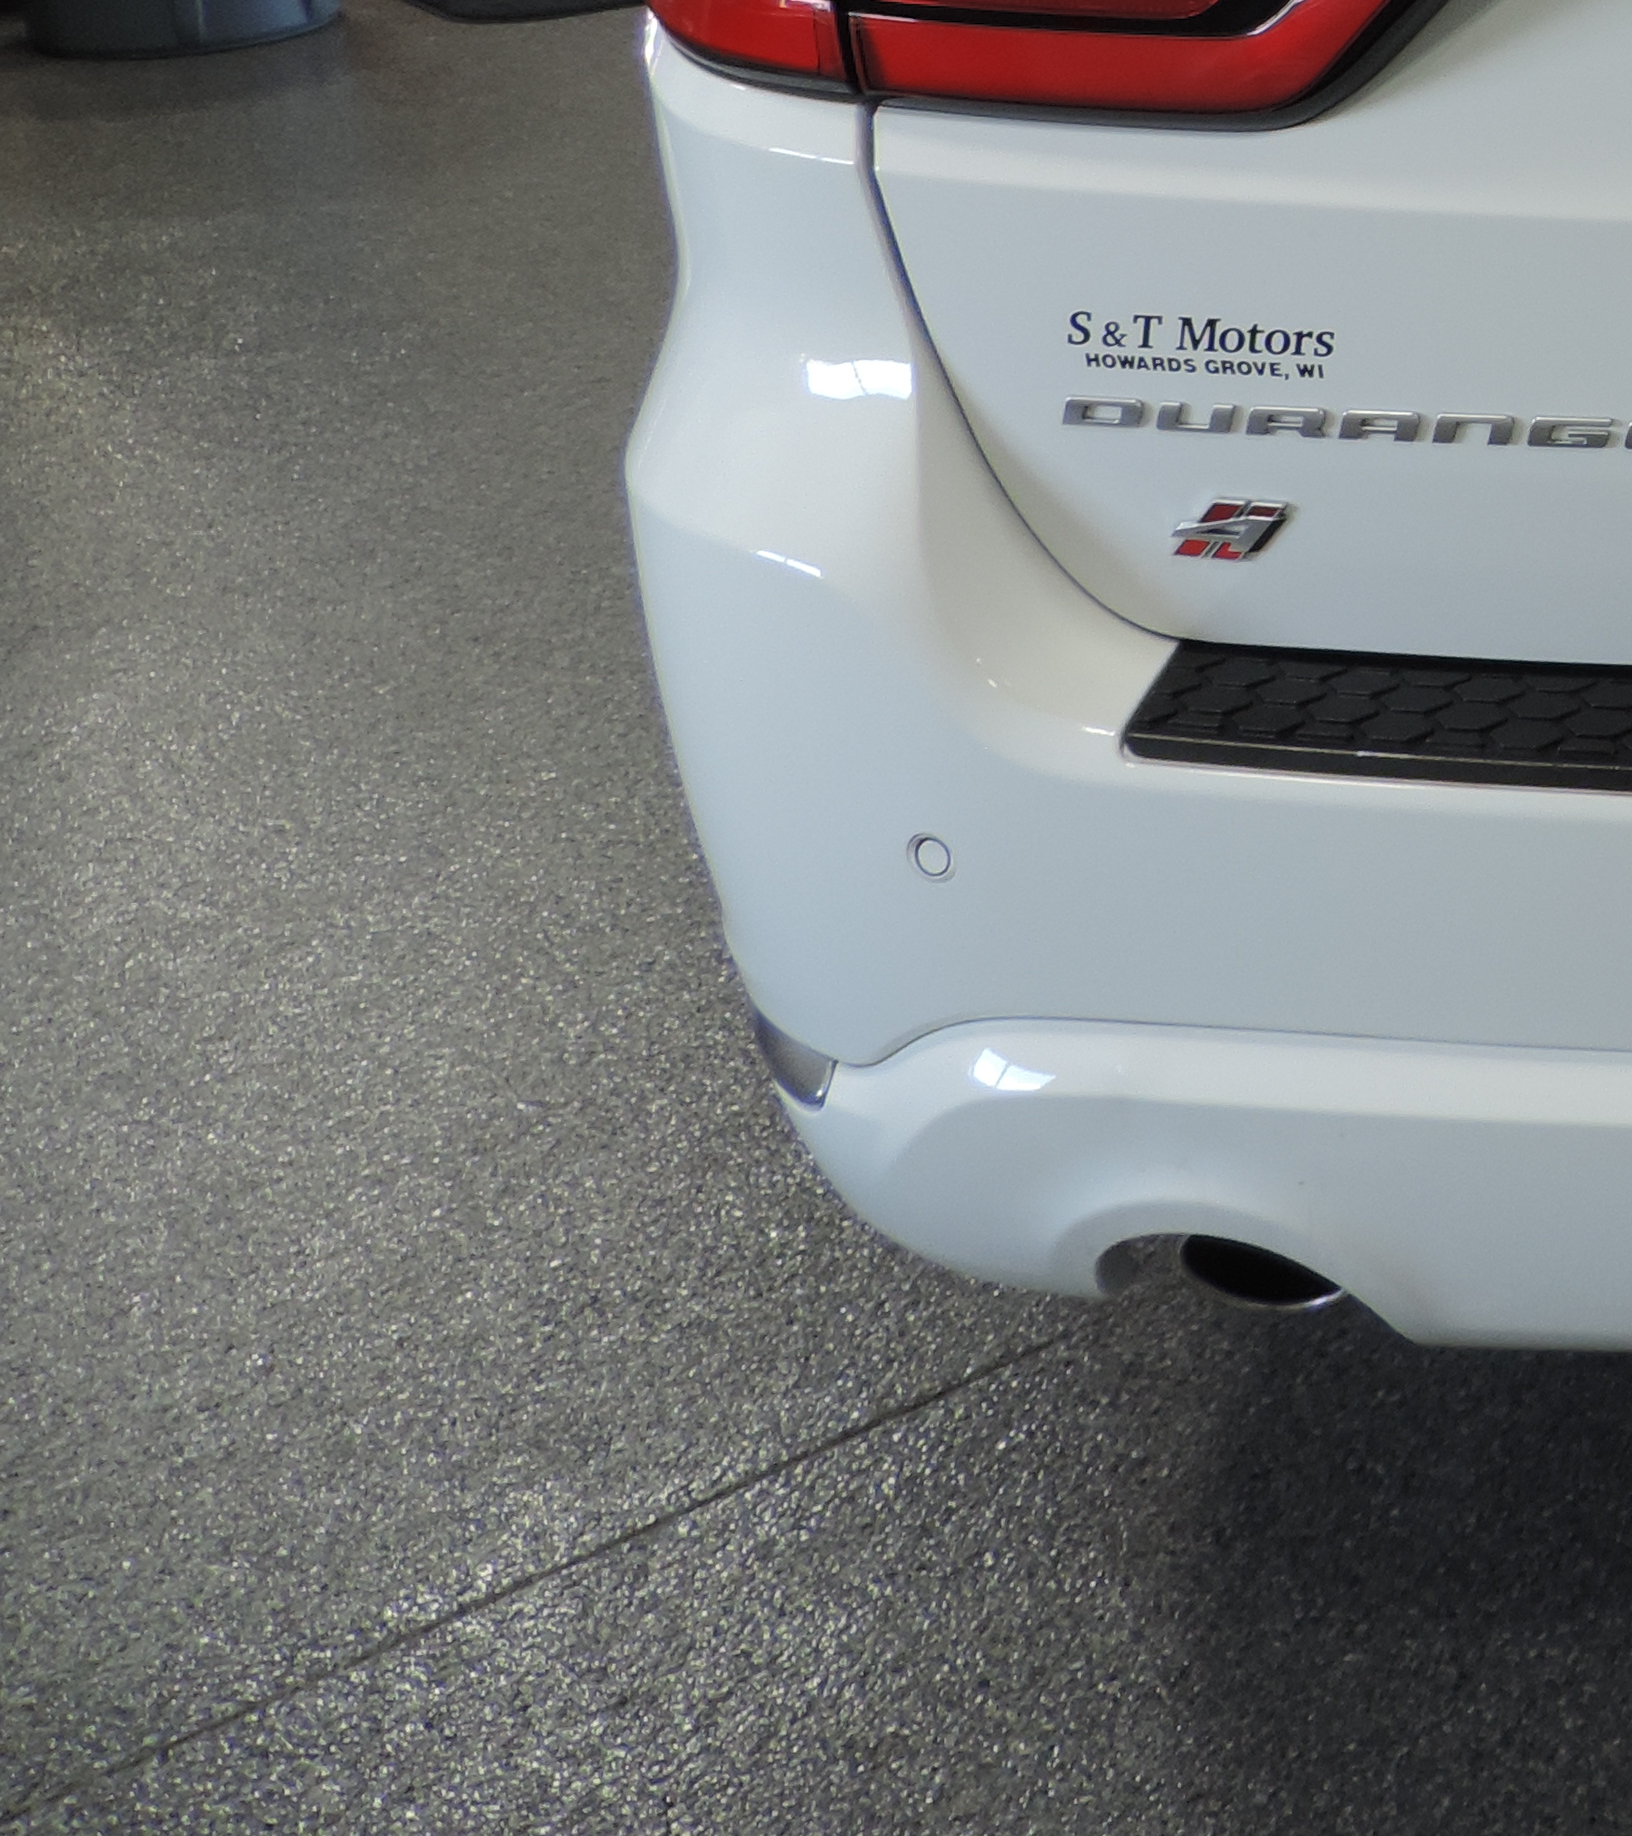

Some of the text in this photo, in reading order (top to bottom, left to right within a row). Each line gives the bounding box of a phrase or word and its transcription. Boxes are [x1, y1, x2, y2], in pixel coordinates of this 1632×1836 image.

[1175, 316, 1336, 358] Motors
[1084, 352, 1325, 381] HOWARDS GROVE, WI
